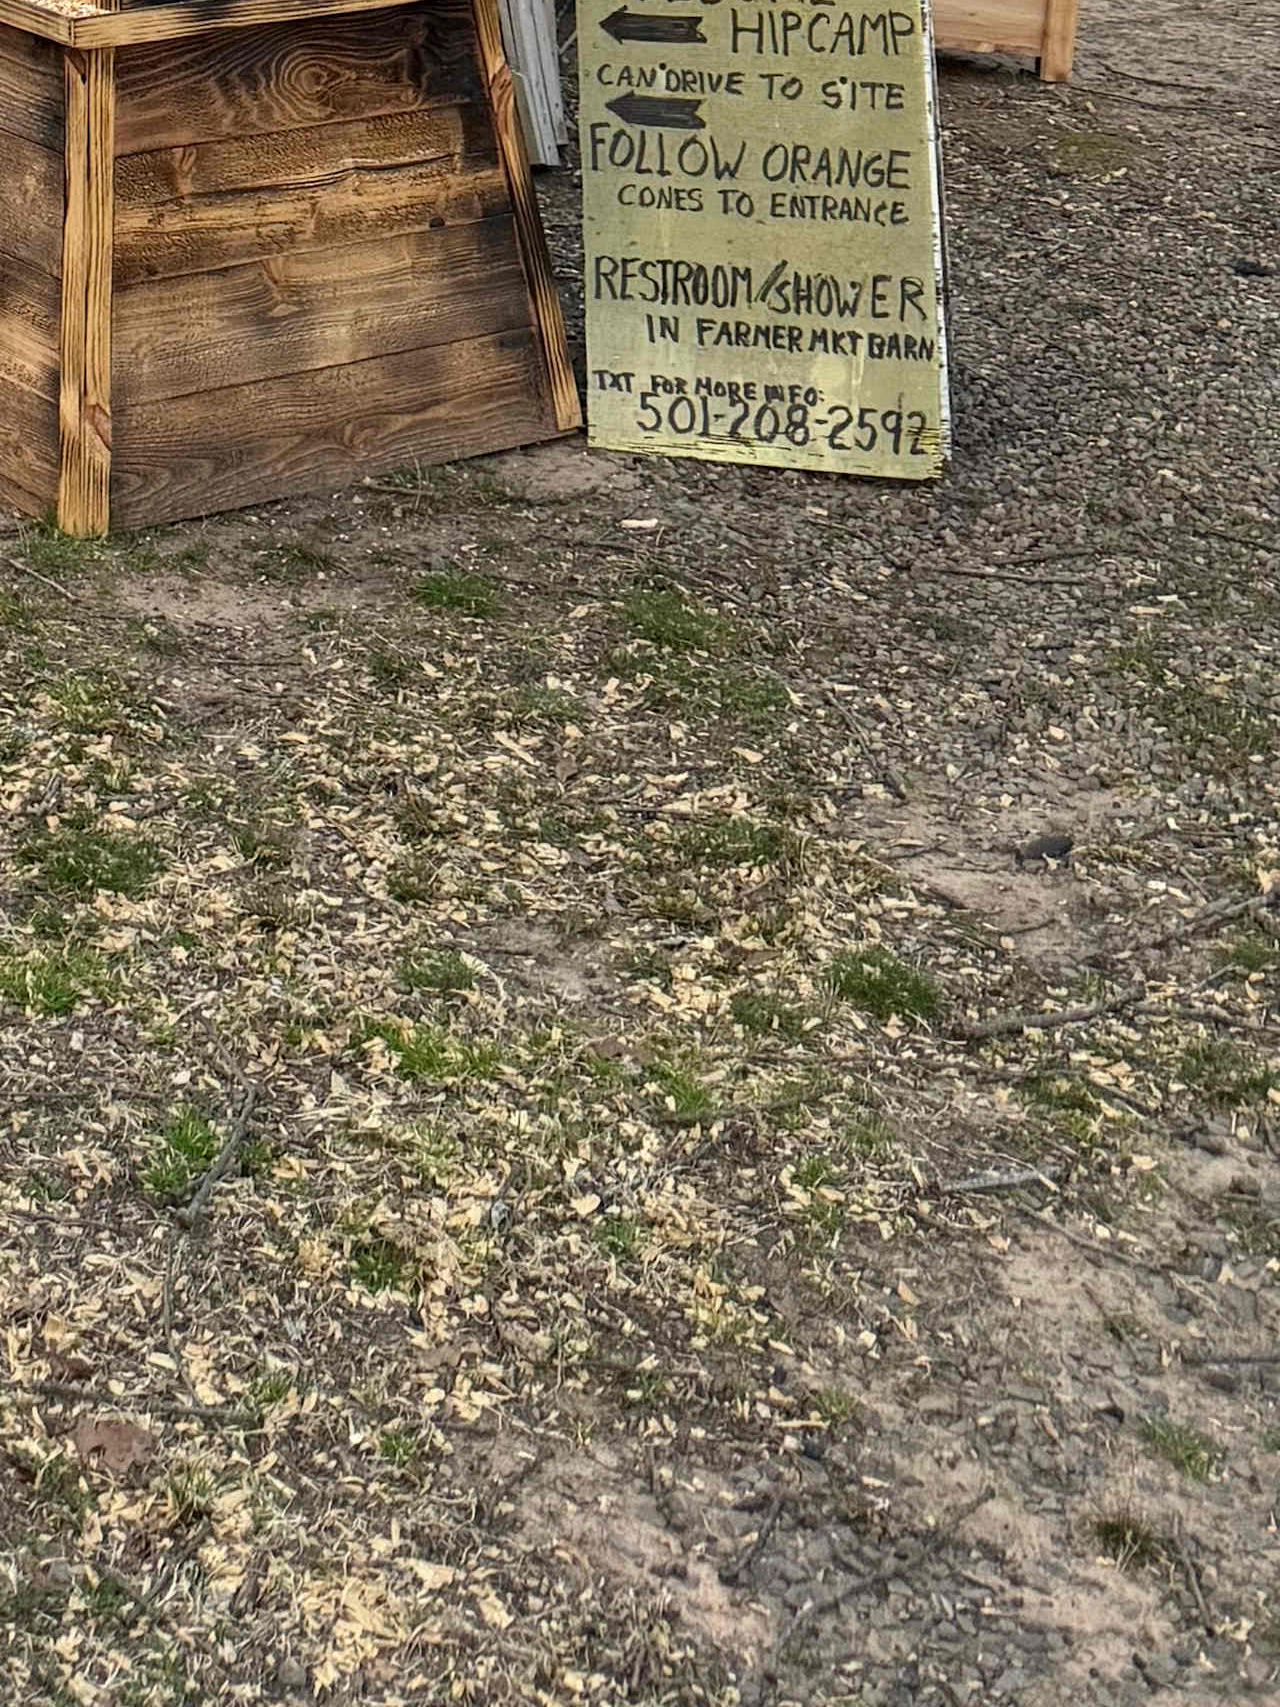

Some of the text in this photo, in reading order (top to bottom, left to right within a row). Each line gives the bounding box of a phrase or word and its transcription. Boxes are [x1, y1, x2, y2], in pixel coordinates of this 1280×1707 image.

[596, 63, 905, 110] CAN DRIVE TO SITE
[590, 122, 911, 189] FOLLOW ORANGE
[618, 184, 909, 226] CONES TO ENTRANCE
[646, 314, 934, 362] IN FARMER MKT BARN
[593, 370, 825, 407] TXT FOR MORE INFO:
[637, 392, 928, 456] 501-208-2592
